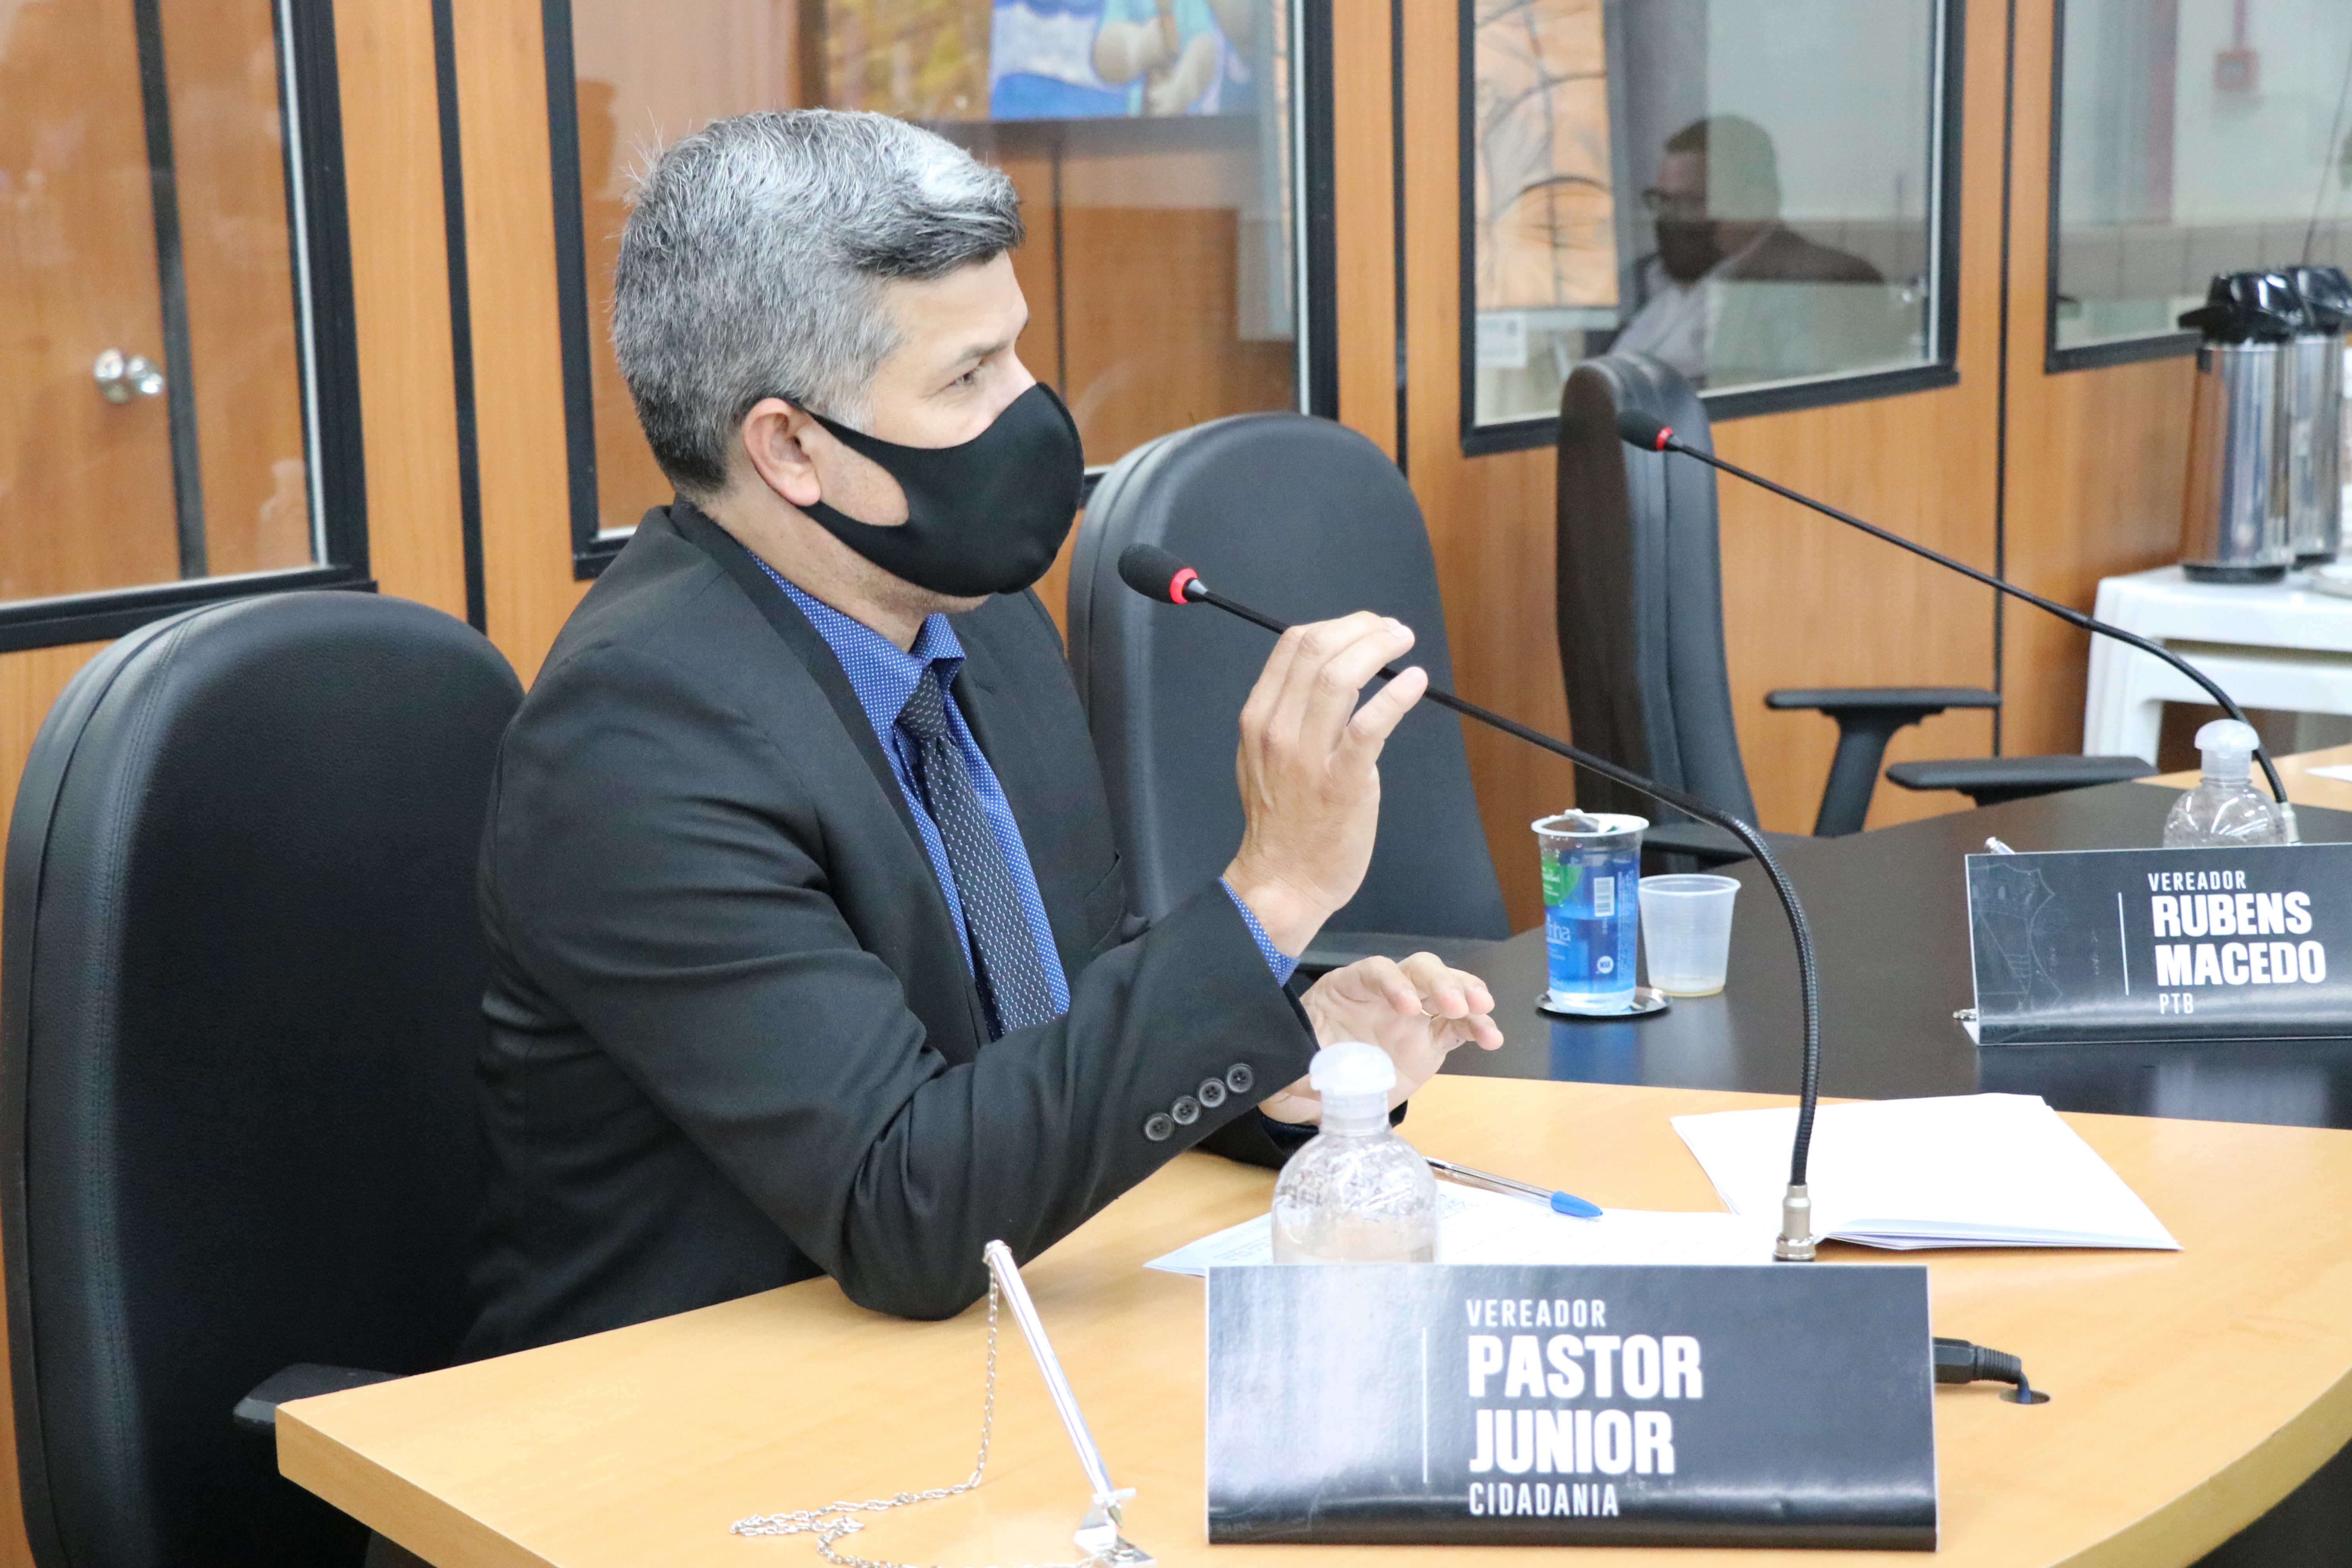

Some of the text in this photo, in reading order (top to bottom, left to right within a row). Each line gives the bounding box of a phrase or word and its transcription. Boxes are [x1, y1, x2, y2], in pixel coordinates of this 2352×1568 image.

[2148, 870, 2247, 891] VEREADOR
[2151, 891, 2312, 937] RUBENS
[2154, 940, 2326, 986] MACEDO
[2159, 993, 2194, 1014] PTB
[1466, 1299, 1606, 1328] VEREADOR
[1468, 1334, 1703, 1399] PASTOR
[1470, 1409, 1675, 1475] JUNIOR
[1469, 1483, 1619, 1516] CIDADANIA
